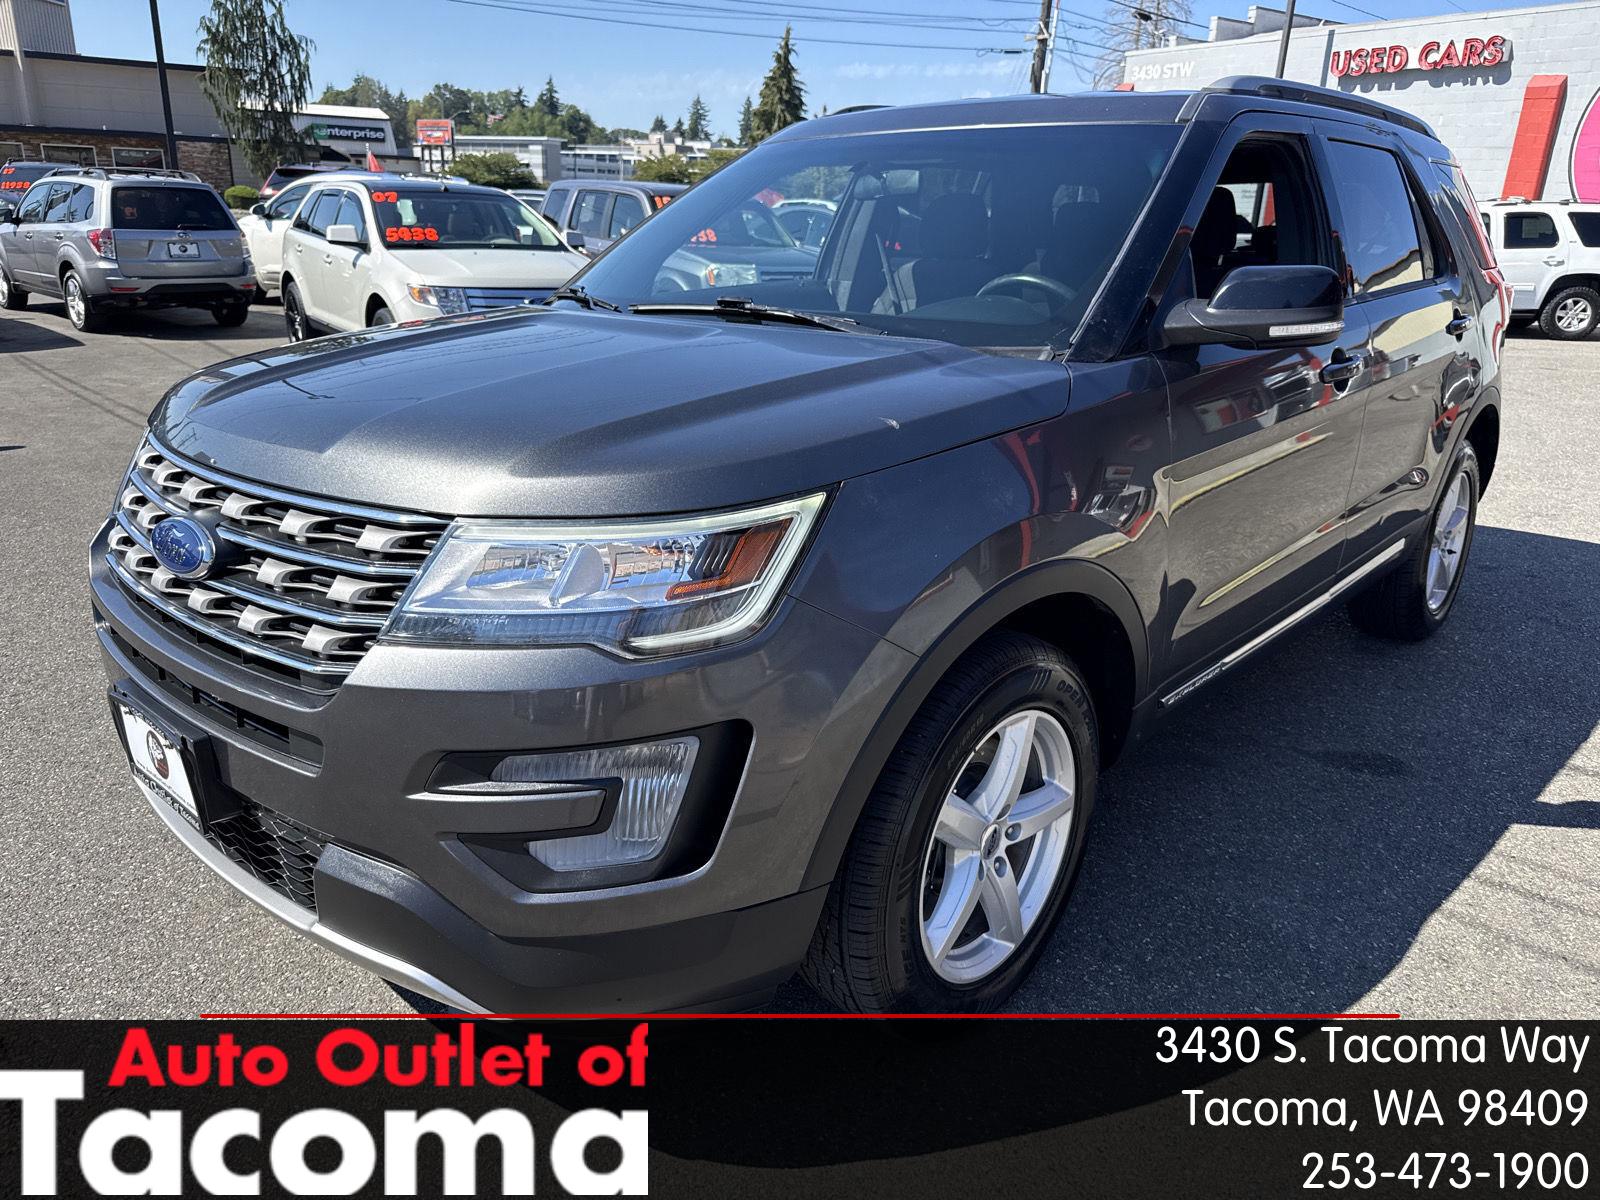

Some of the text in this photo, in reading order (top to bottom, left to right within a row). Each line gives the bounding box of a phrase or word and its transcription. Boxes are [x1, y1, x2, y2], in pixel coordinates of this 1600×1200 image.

[1330, 35, 1505, 78] USED CARS
[1131, 61, 1195, 80] 3430 STW
[314, 126, 385, 140] enterprise
